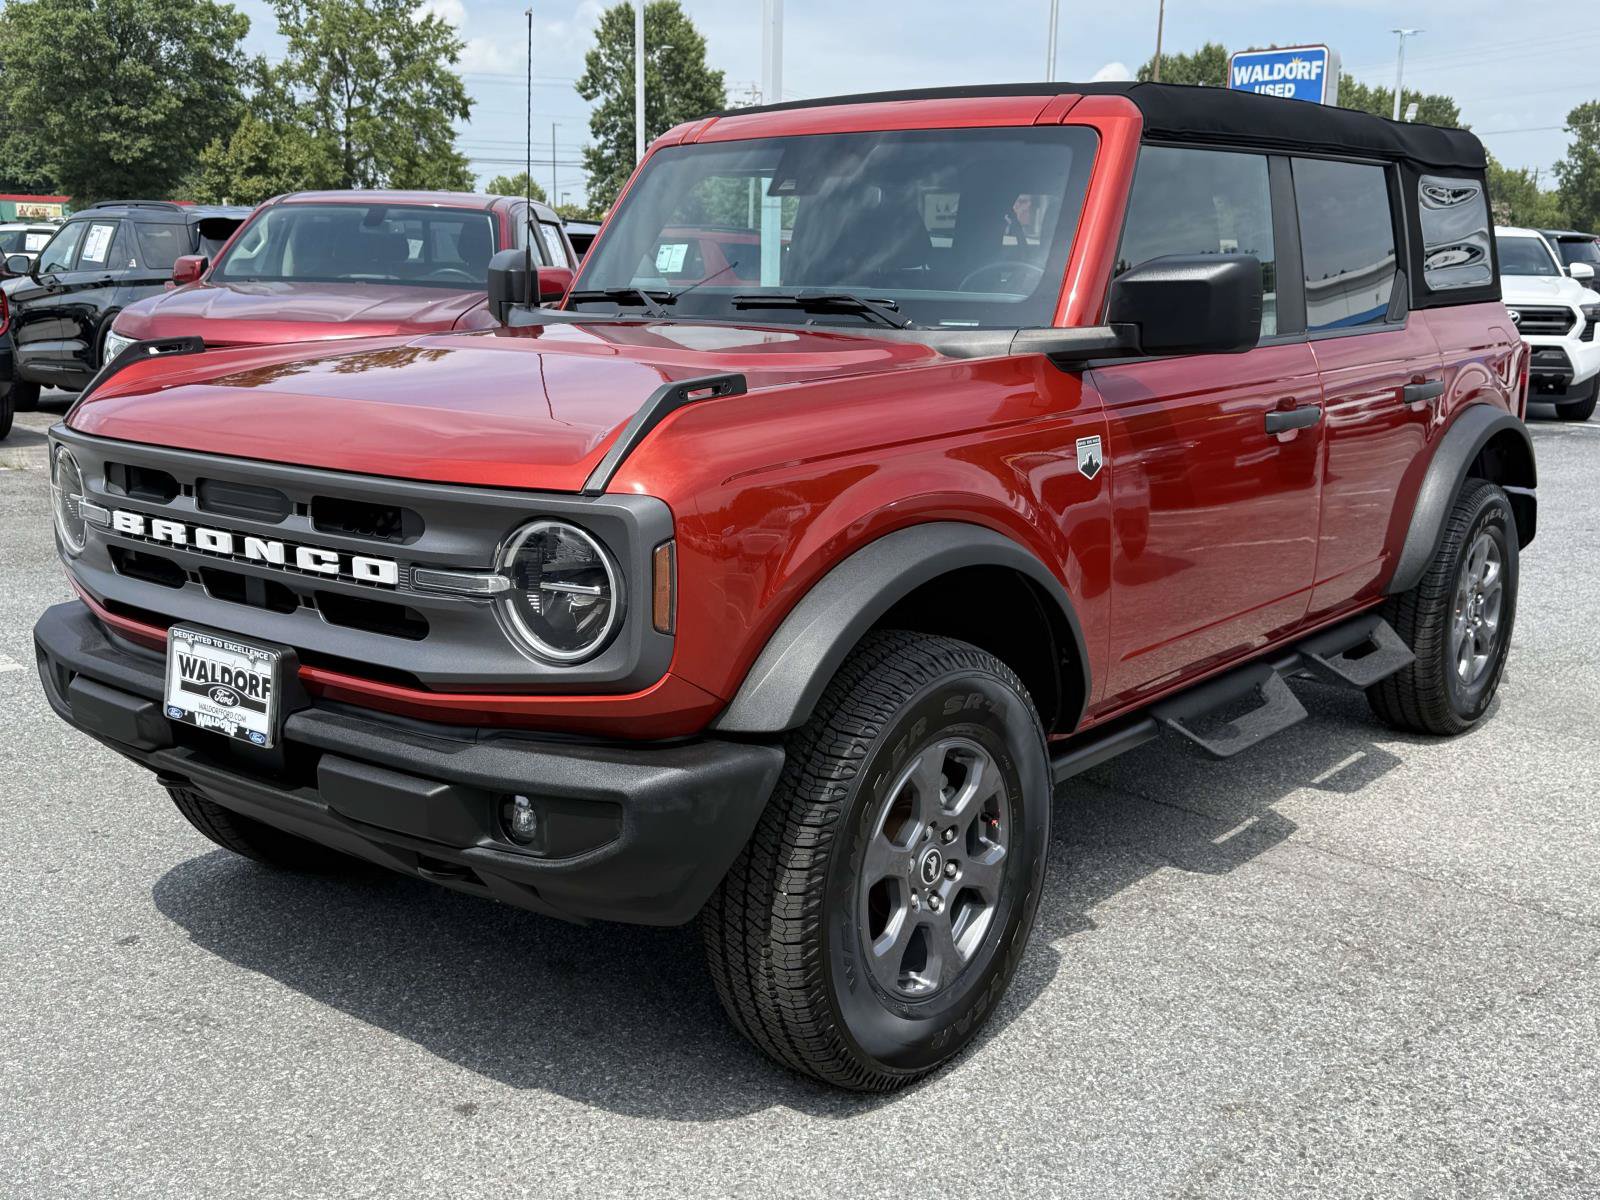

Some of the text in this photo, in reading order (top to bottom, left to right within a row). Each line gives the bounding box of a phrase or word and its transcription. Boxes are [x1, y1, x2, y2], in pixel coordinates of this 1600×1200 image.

[1233, 60, 1324, 87] WALDORF
[1254, 83, 1296, 98] USED
[112, 510, 399, 585] BRONCO
[173, 630, 268, 660] DEDICATED TO EXCELLENCE
[178, 654, 271, 700] WALDORF
[213, 688, 236, 706] Ford
[194, 711, 239, 736] WALDORF
[198, 702, 247, 723] WALDORFFORD.COM
